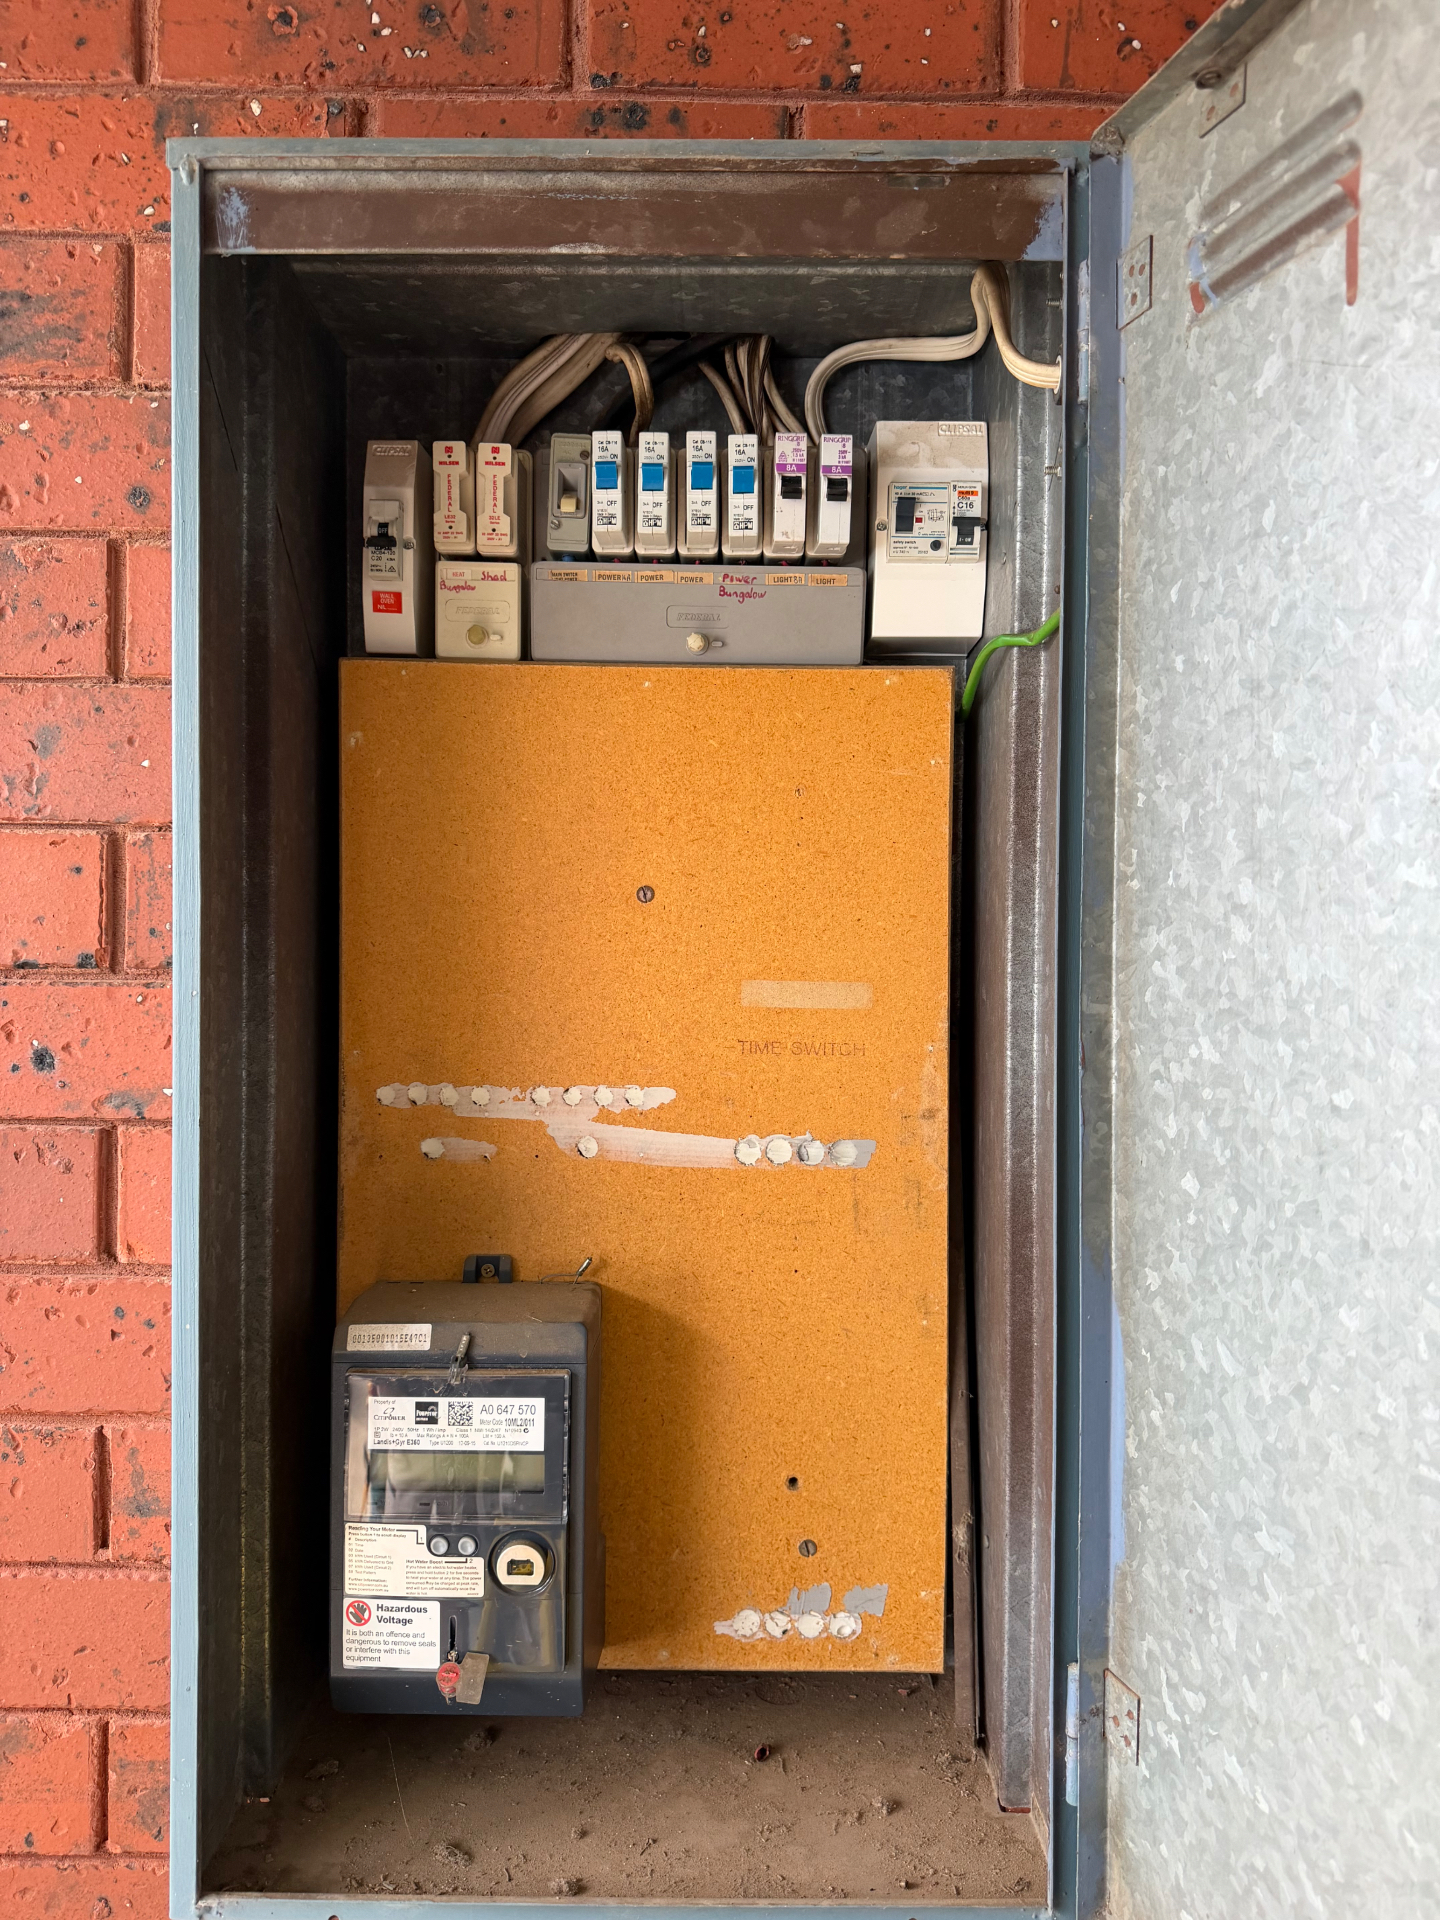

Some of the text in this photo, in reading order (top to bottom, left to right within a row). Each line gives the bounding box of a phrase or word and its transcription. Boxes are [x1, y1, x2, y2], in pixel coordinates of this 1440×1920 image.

[940, 423, 983, 435] CLIPSAL
[374, 446, 410, 456] CLIPSAL
[602, 516, 617, 525] HPM
[648, 518, 662, 527] HPM
[697, 517, 711, 525] HPM
[739, 521, 753, 530] HPM
[722, 573, 757, 585] Power
[718, 585, 767, 604] Bungalow
[455, 606, 500, 615] FEDERAL
[676, 613, 721, 621] FEDERAL
[738, 1040, 866, 1056] TIME SWITCH
[480, 1404, 536, 1415] A0 647 570
[376, 1604, 428, 1613] Hazardous
[376, 1615, 413, 1626] Voltage
[346, 1638, 382, 1646] dangerous
